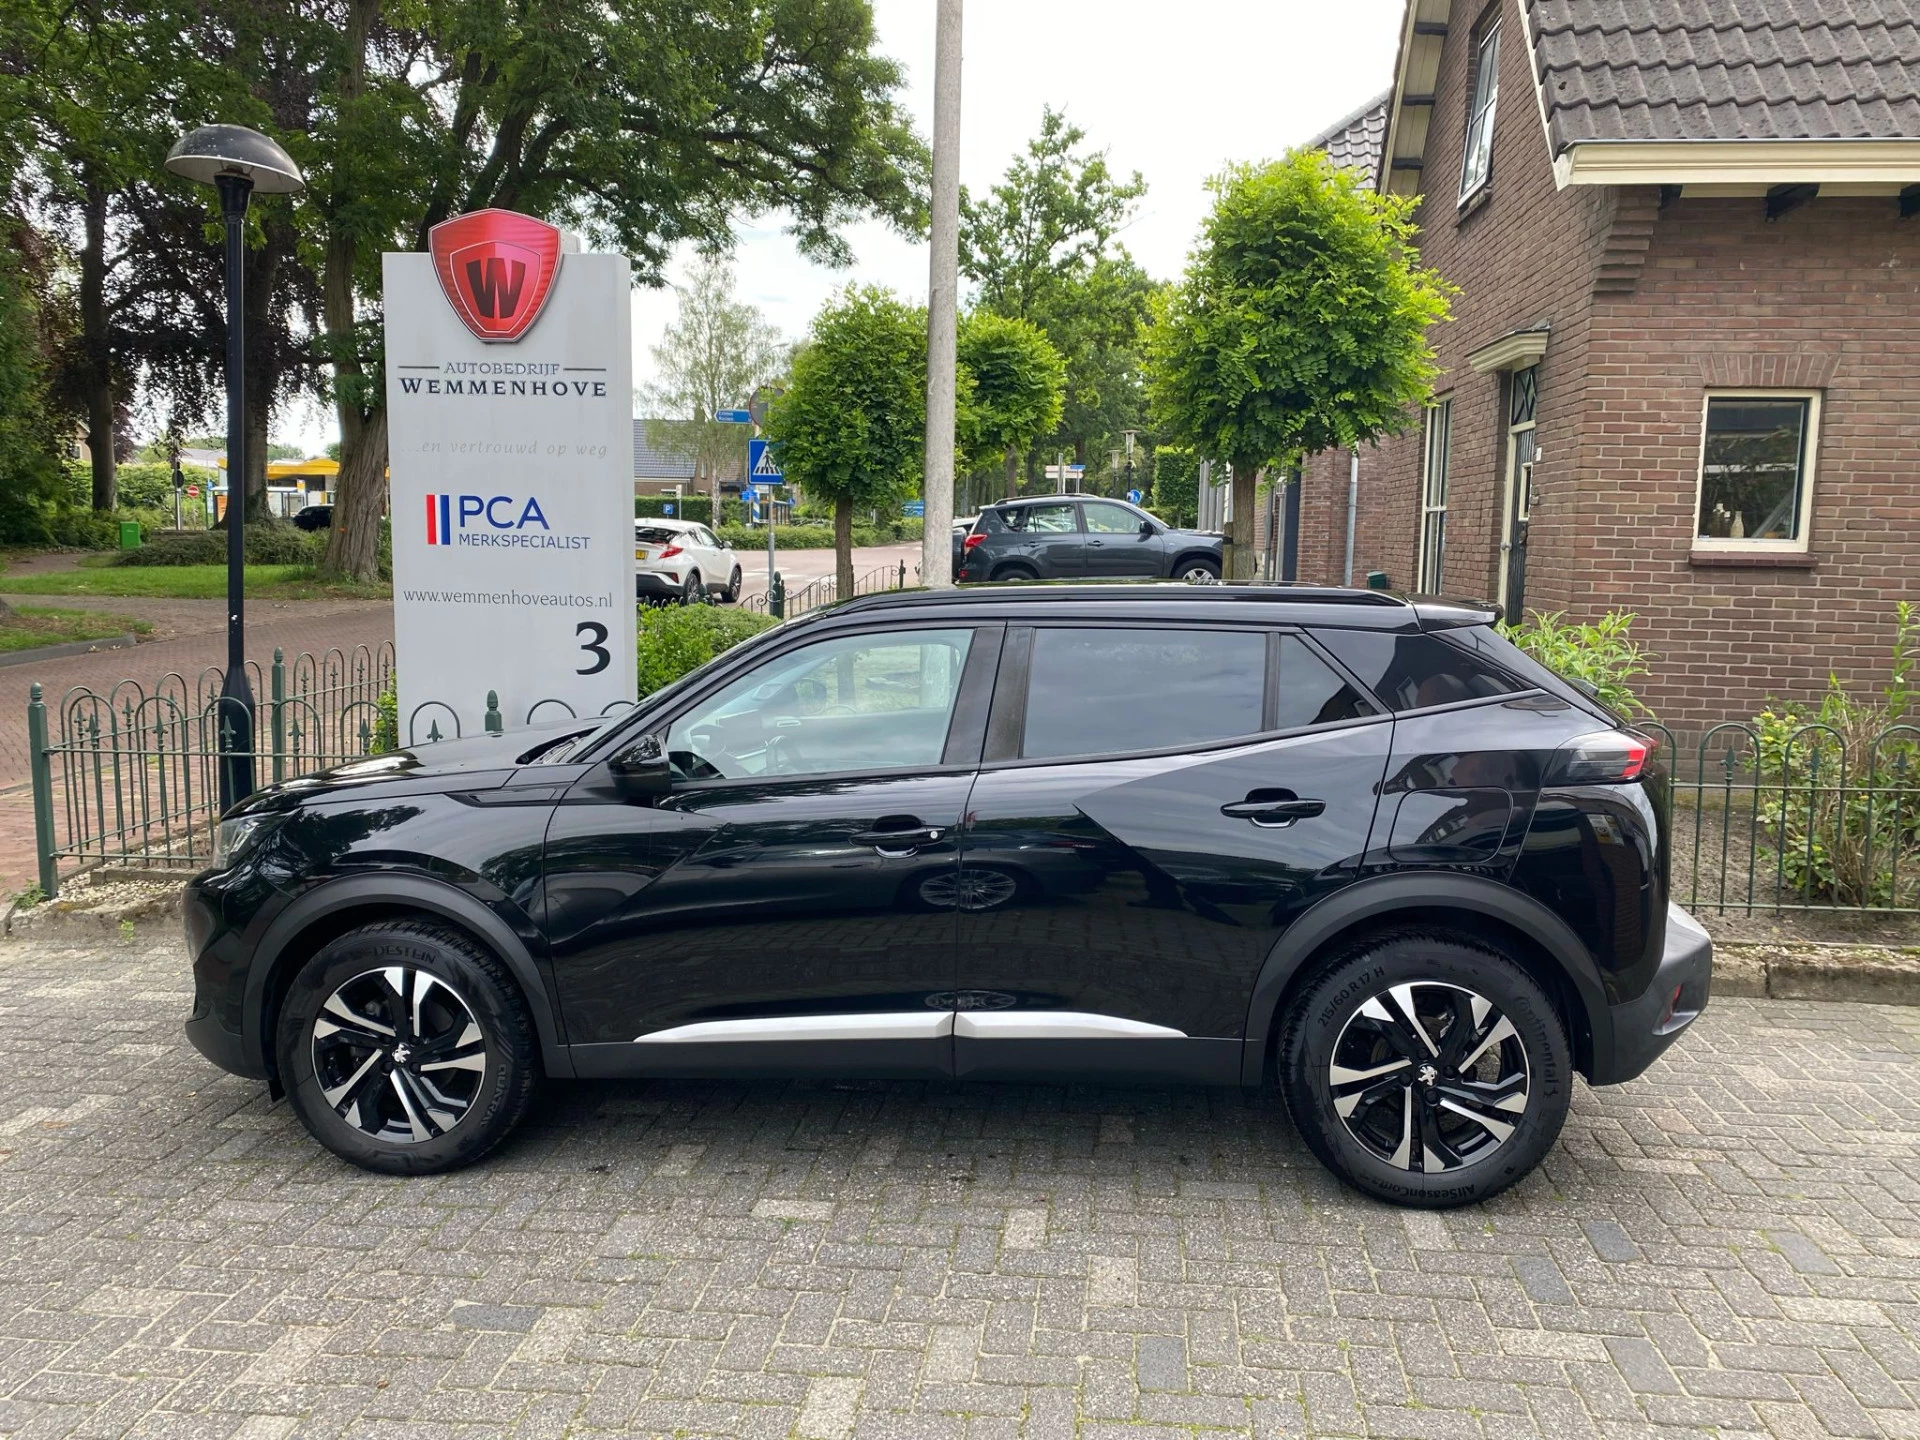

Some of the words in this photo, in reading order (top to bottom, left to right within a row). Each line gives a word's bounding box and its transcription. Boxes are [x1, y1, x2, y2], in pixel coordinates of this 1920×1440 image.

[465, 257, 526, 319] W
[444, 362, 560, 376] AUTOBEDRIJF
[398, 378, 606, 397] WEMMENHOVE
[450, 439, 537, 454] vertrouwd
[546, 444, 567, 458] op
[576, 444, 608, 460] weg
[459, 495, 550, 530] PCA
[459, 533, 591, 550] MERKSPECIALIST
[403, 590, 613, 608] www.wemmenhoveautos.nl
[575, 621, 611, 676] 3
[1318, 989, 1350, 1027] 215/60
[1348, 981, 1361, 992] R
[1359, 972, 1371, 985] 17
[1373, 966, 1385, 978] H
